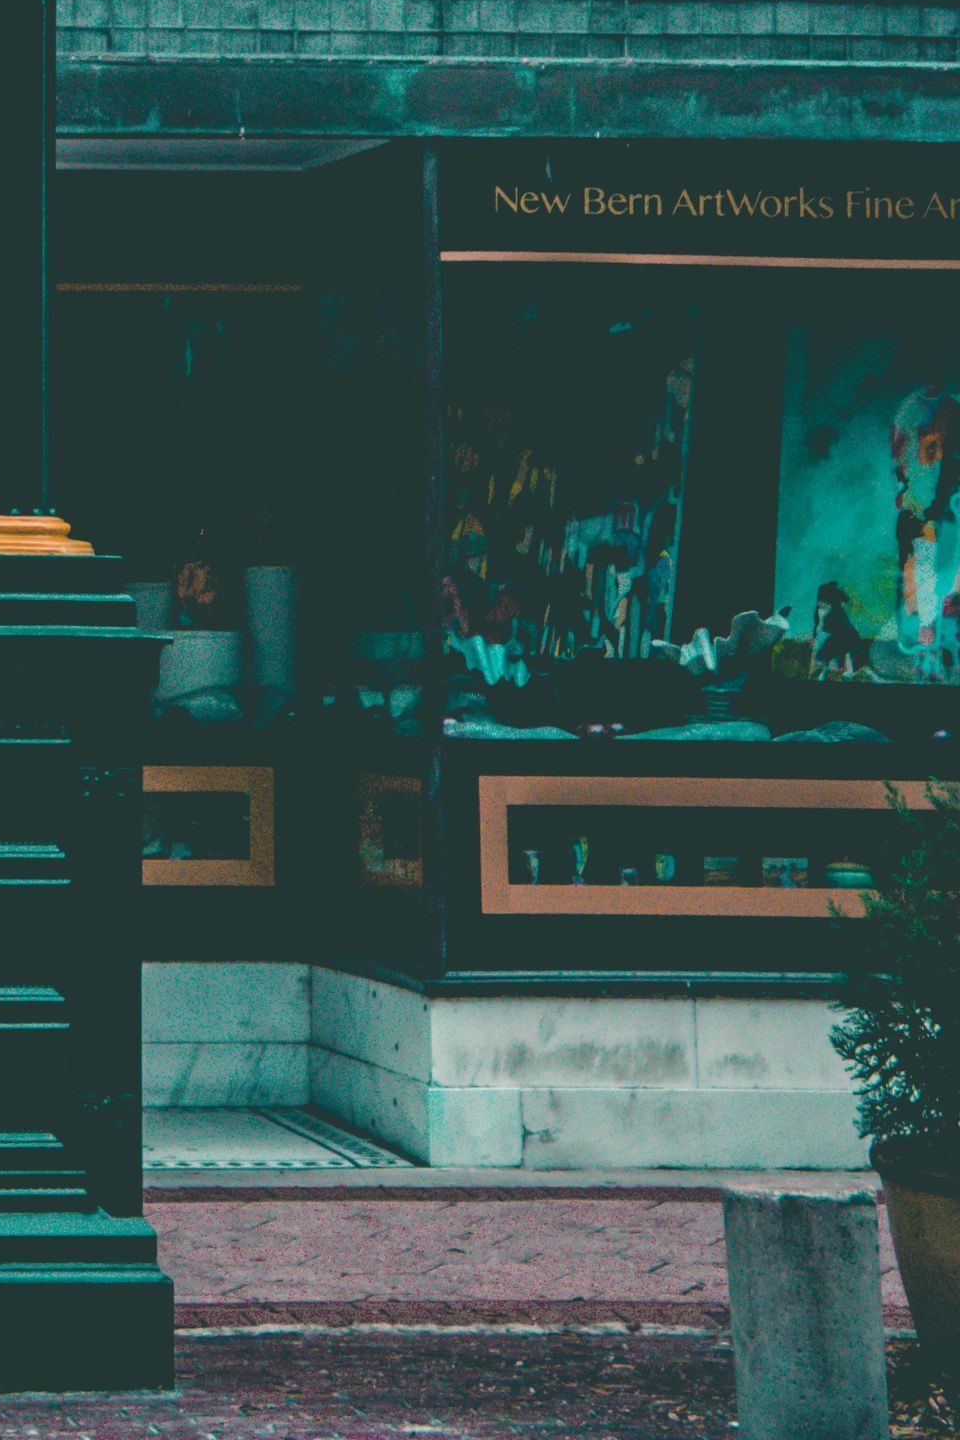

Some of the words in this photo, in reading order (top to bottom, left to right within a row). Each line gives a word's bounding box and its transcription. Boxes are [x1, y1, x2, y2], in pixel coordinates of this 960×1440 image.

[494, 186, 571, 214] New
[583, 187, 663, 216] Bern
[672, 187, 834, 219] ArtWorks
[846, 187, 915, 219] Fine
